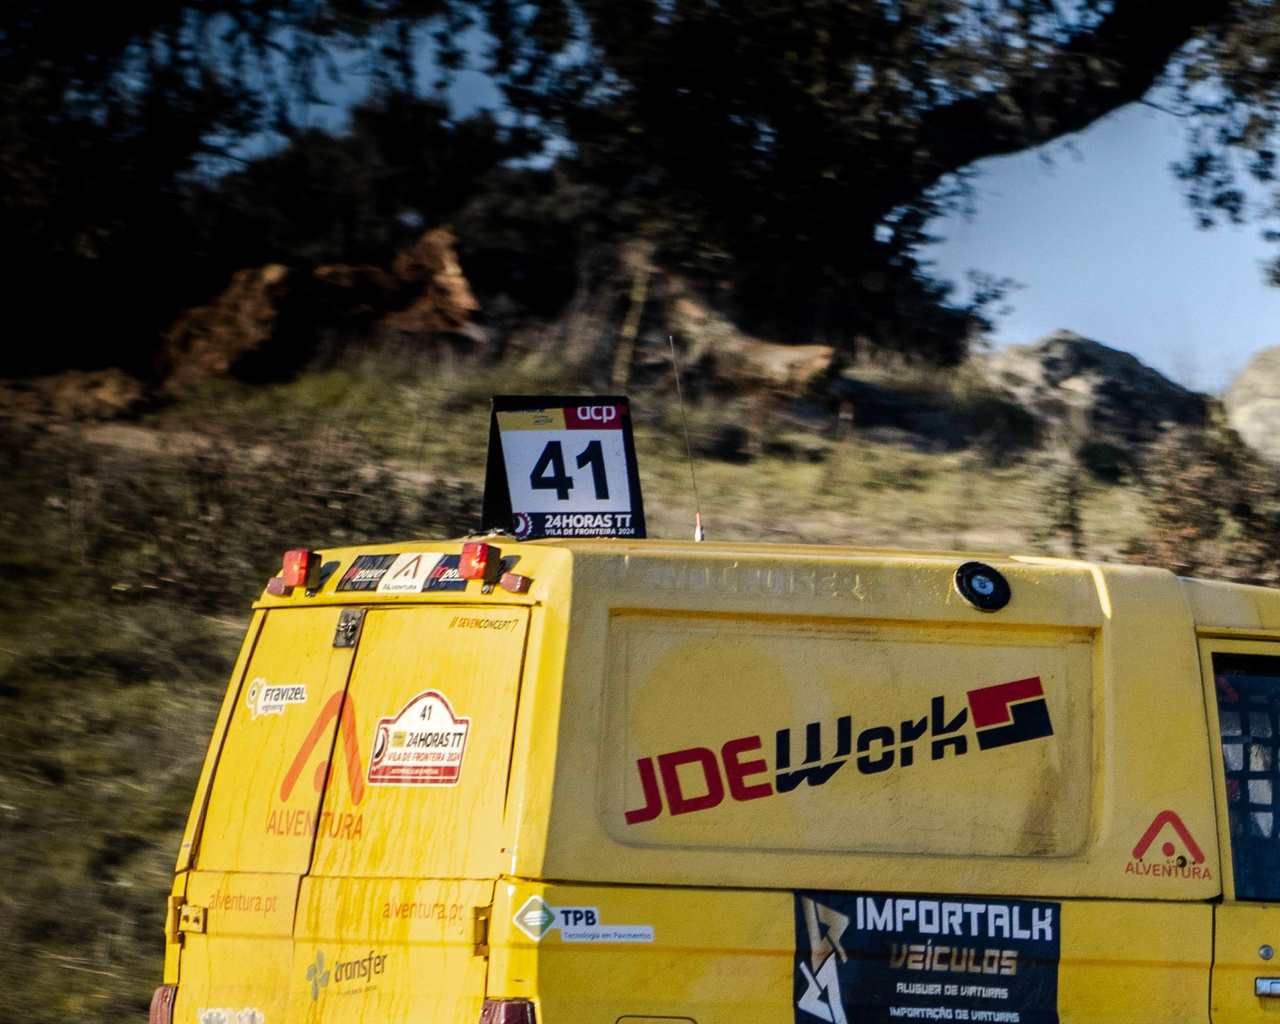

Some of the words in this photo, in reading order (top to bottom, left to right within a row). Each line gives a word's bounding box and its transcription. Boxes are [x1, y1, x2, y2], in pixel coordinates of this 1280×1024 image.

[577, 405, 616, 423] acp
[529, 440, 610, 500] 41
[614, 514, 632, 527] TT
[618, 527, 635, 535] 2024
[420, 704, 433, 721] 41
[451, 732, 465, 748] TT
[388, 752, 402, 761] VILA
[402, 752, 412, 761] DE
[412, 752, 446, 761] FRONTEIRA
[446, 752, 461, 761] 2024
[266, 809, 364, 841] ALVENTURA
[1125, 861, 1212, 880] ALVENTURA
[208, 889, 278, 919] alventura.pt
[383, 897, 465, 927] alventura.pt
[560, 910, 597, 926] TPB
[856, 897, 1054, 941] IMPORTALK
[564, 932, 600, 941] Tecnologia
[613, 932, 652, 940] Pavimentos
[890, 939, 1019, 976] VEÍCULOS
[335, 950, 388, 983] transfer
[896, 982, 942, 996] ALUGUER
[944, 984, 958, 996] DE
[955, 1008, 969, 1021] DE
